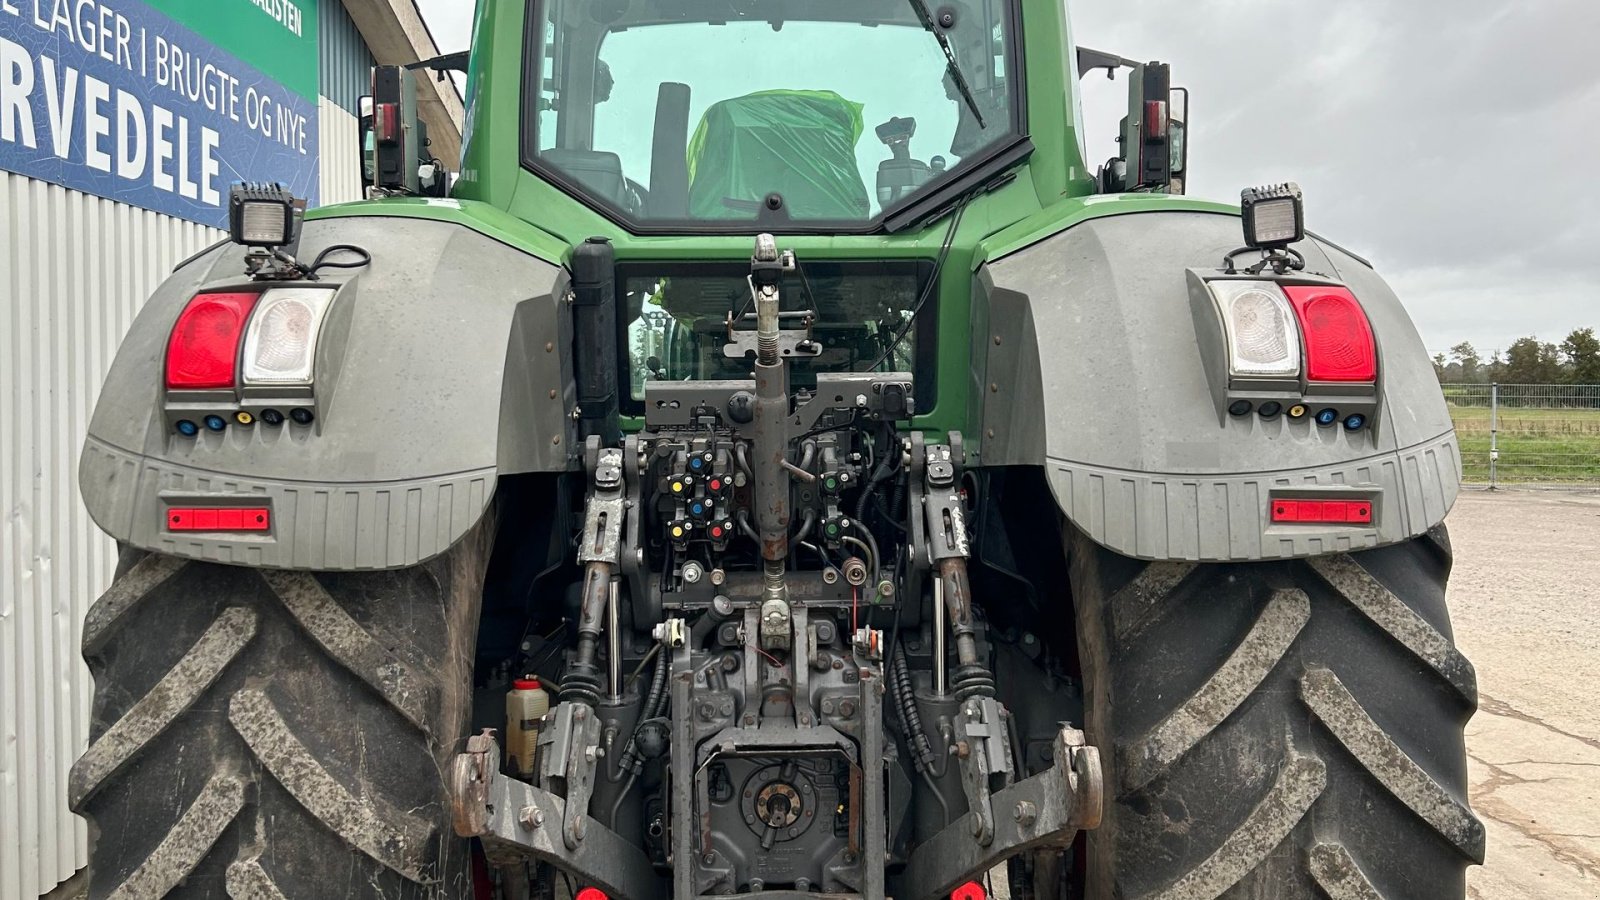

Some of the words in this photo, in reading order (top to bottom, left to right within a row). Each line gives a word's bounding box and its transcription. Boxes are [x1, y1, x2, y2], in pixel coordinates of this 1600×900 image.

[0, 36, 220, 206] RVEDELE
[140, 28, 146, 77] I
[155, 36, 239, 122] BRUGTE
[245, 87, 271, 137] OG
[277, 103, 306, 154] NYE
